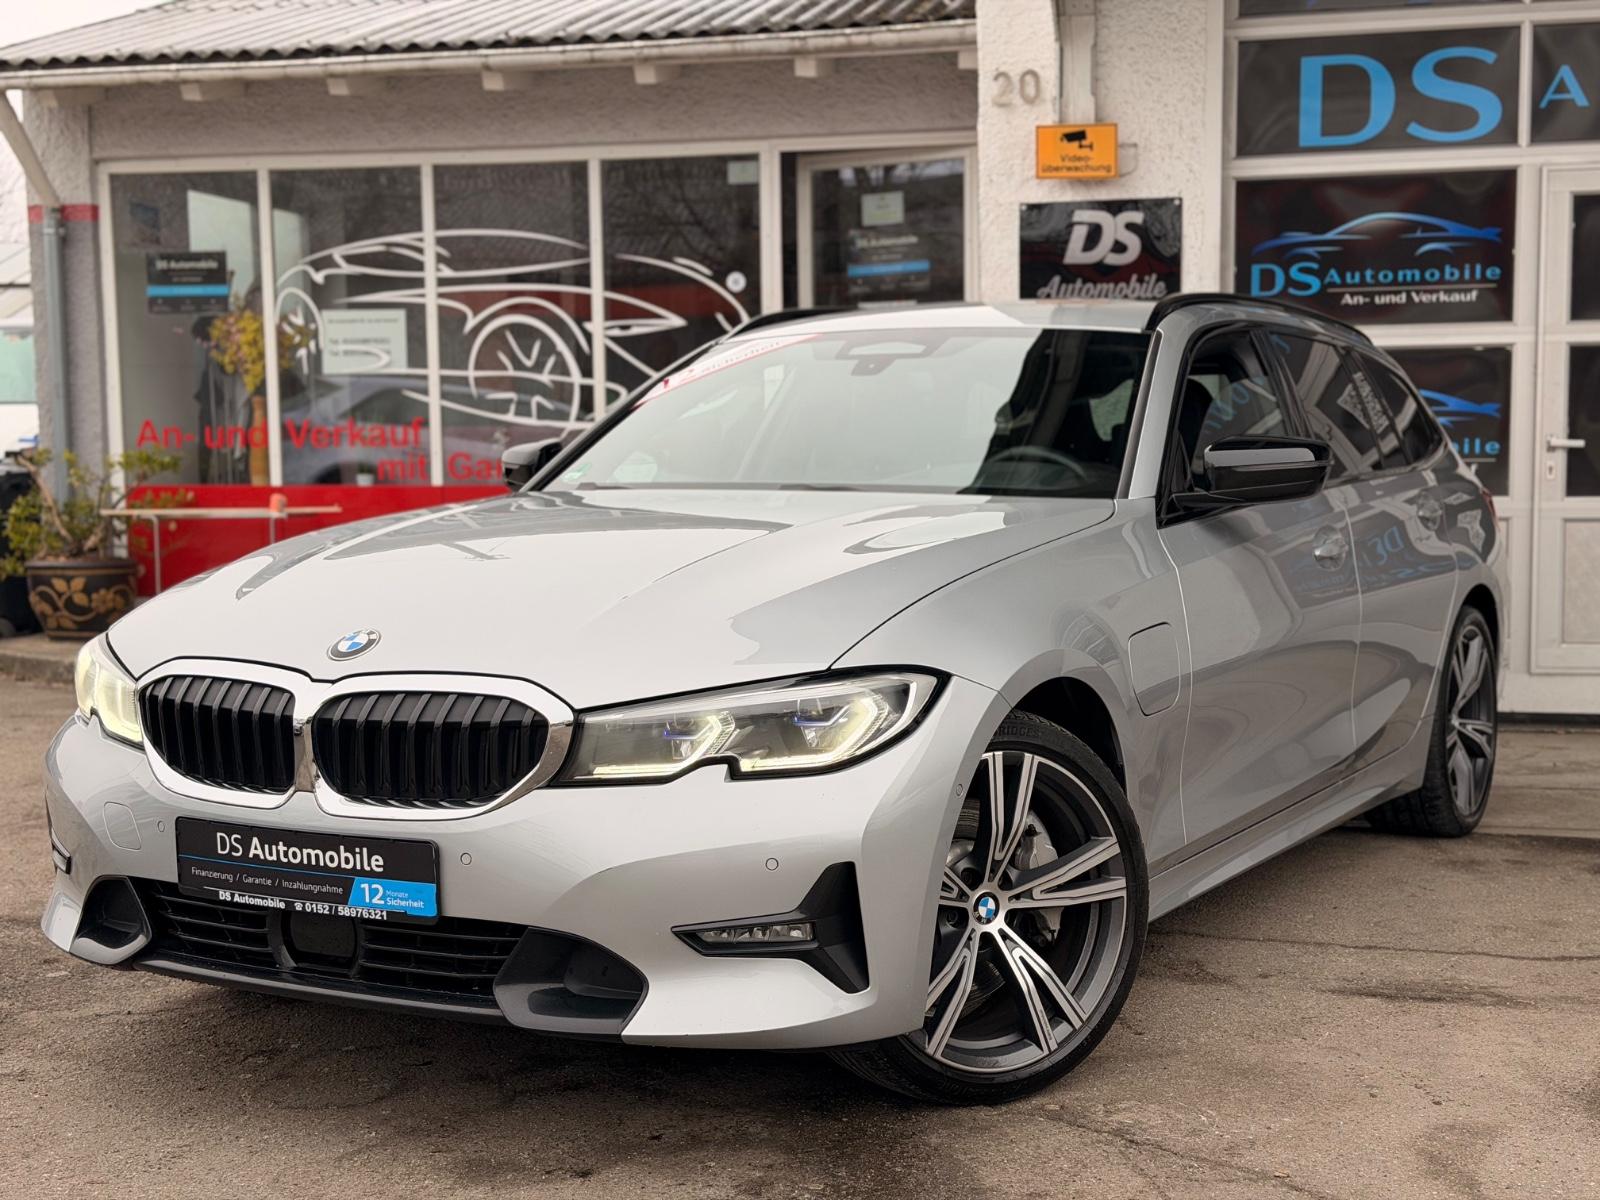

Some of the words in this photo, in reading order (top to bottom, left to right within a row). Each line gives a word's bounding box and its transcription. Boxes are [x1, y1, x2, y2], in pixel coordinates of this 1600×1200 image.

[992, 69, 1040, 107] 20
[1299, 46, 1503, 147] DS
[1063, 209, 1144, 266] DS
[1037, 273, 1168, 298] Automobile
[1251, 262, 1321, 297] DS
[1324, 263, 1502, 284] Automobile
[1340, 292, 1370, 305] An-
[1374, 292, 1406, 304] und
[1411, 290, 1478, 304] Verkauf
[136, 418, 196, 448] An-
[204, 417, 268, 449] und
[285, 416, 426, 449] Verkauf
[376, 452, 428, 481] mit
[216, 832, 243, 857] DS
[248, 837, 384, 872] Automobile
[191, 867, 233, 882] Finanzierung
[242, 874, 272, 886] Garantie
[282, 880, 343, 895] Inzahlungnahme
[360, 883, 385, 904] 12
[219, 890, 231, 901] DS
[233, 894, 285, 909] Automobile
[305, 903, 329, 914] 0152
[338, 906, 387, 920] 58976321
[386, 898, 424, 908] Sicherheit
